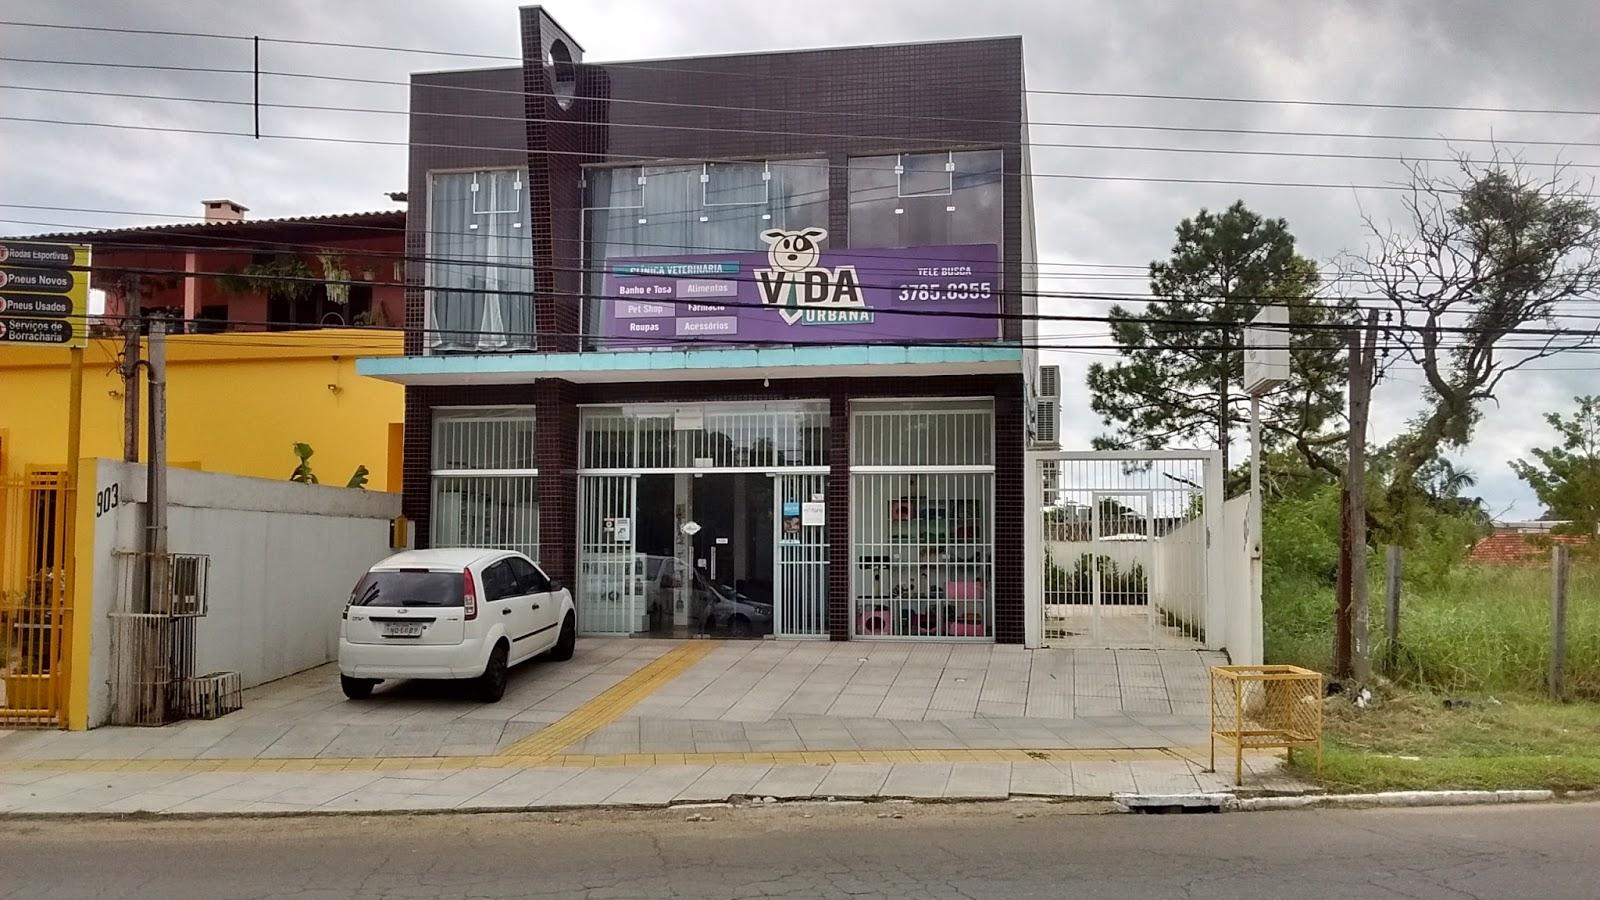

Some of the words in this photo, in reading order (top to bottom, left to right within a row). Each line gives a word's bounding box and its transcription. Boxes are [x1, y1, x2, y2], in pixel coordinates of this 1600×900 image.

[10, 249, 31, 258] Rodas
[33, 251, 69, 260] Esportivas
[918, 267, 938, 276] TELE
[941, 267, 972, 276] BUSCA
[8, 273, 36, 284] Pneus
[39, 275, 67, 286] Novos
[620, 286, 644, 294] Banho
[654, 285, 672, 294] Tosa
[687, 283, 729, 293] Alimentos
[757, 268, 861, 310] VIDA
[7, 300, 33, 310] Pneus
[35, 301, 66, 312] Usados
[628, 305, 641, 313] Pet
[643, 304, 663, 314] Shop
[806, 309, 870, 322] URBANA
[9, 320, 49, 332] Serviços
[51, 322, 63, 331] de
[630, 322, 659, 332] Roupas
[685, 321, 729, 331] Acessórios
[9, 331, 62, 341] Borracharia
[97, 483, 119, 517] 903
